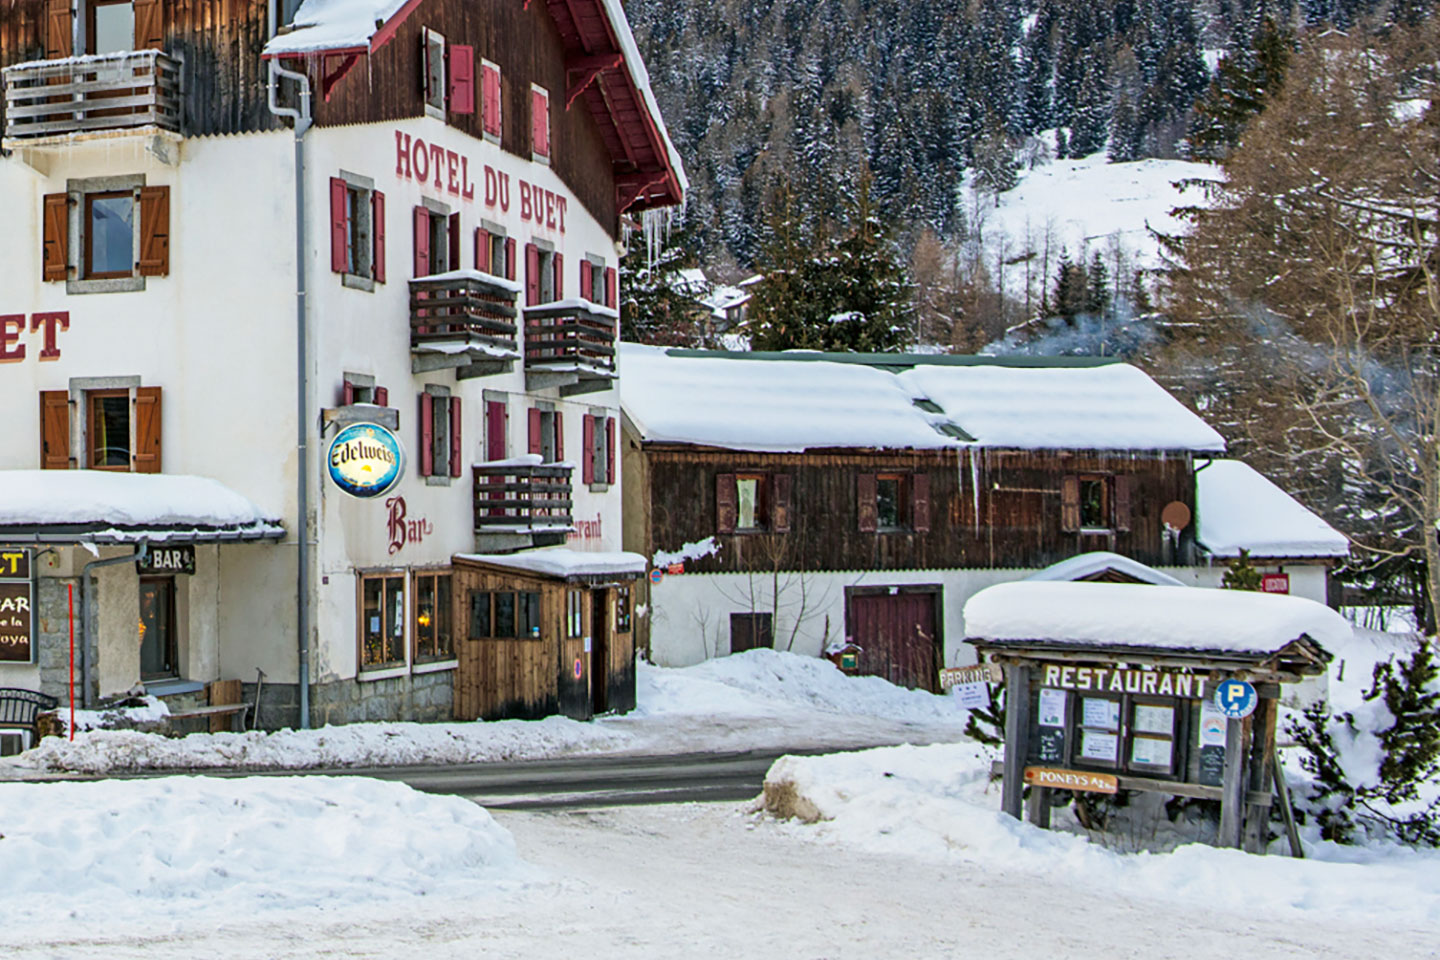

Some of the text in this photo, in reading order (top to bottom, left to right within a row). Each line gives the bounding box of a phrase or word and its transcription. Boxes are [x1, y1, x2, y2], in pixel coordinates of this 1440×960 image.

[394, 129, 567, 234] HOTEL DU BUET
[330, 440, 396, 468] Edelweiss
[385, 496, 433, 555] Bar
[153, 549, 183, 569] BAR
[11, 616, 22, 627] la
[940, 667, 992, 689] PARKING
[1044, 665, 1210, 698] RESTAURANT
[1227, 684, 1245, 702] P
[1040, 771, 1089, 786] PONEYS
